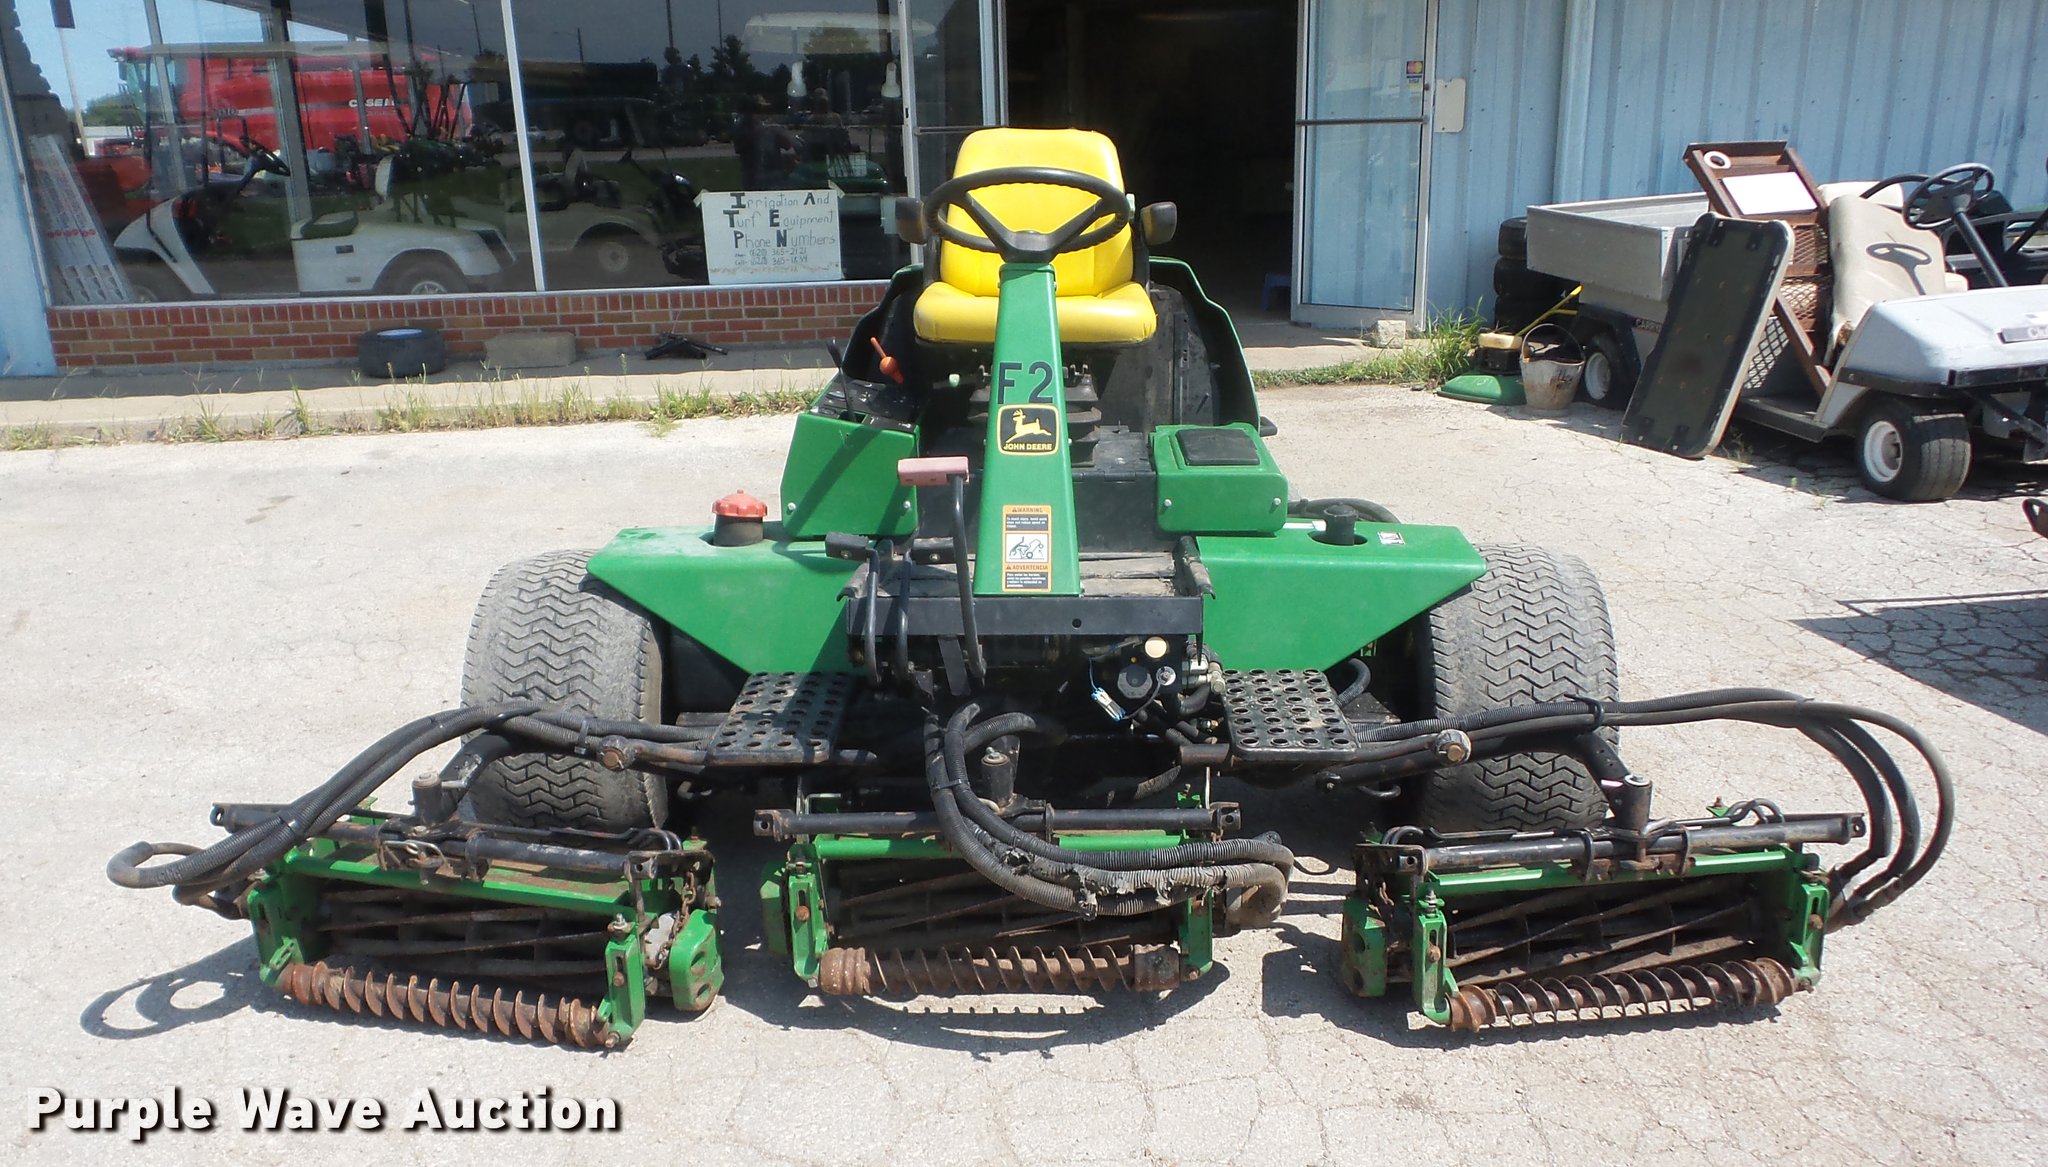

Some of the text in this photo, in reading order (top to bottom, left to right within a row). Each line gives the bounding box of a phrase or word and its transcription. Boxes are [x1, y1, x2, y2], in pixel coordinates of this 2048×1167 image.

[348, 98, 383, 108] CSE
[730, 191, 830, 211] Irrigation And
[722, 208, 835, 230] Turf Equipment
[733, 228, 836, 249] Phone Numbers
[997, 360, 1054, 405] F2
[1003, 443, 1053, 451] JOHN DEERE
